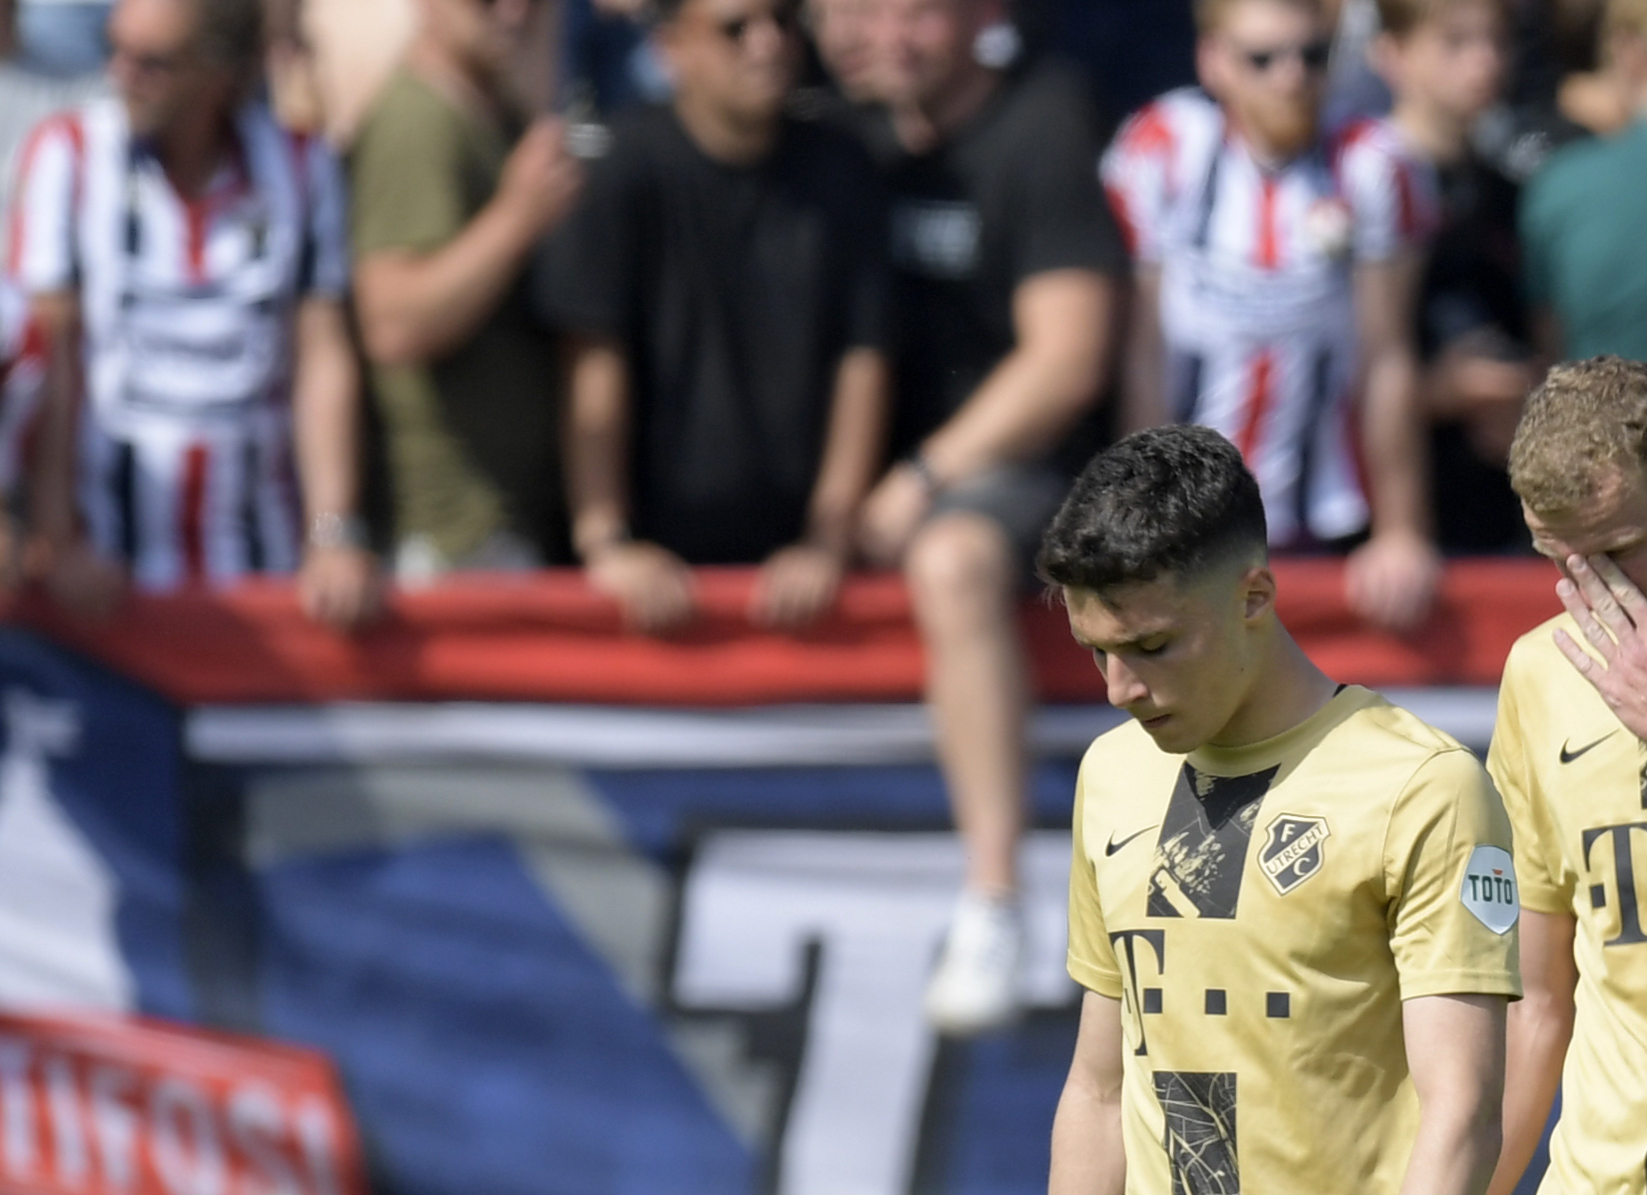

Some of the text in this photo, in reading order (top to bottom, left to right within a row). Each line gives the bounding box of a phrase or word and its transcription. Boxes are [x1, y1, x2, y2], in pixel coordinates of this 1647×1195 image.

[1281, 823, 1296, 842] F
[1266, 825, 1323, 874] UTRECHT
[1293, 857, 1311, 876] C
[1468, 874, 1513, 905] TOTO
